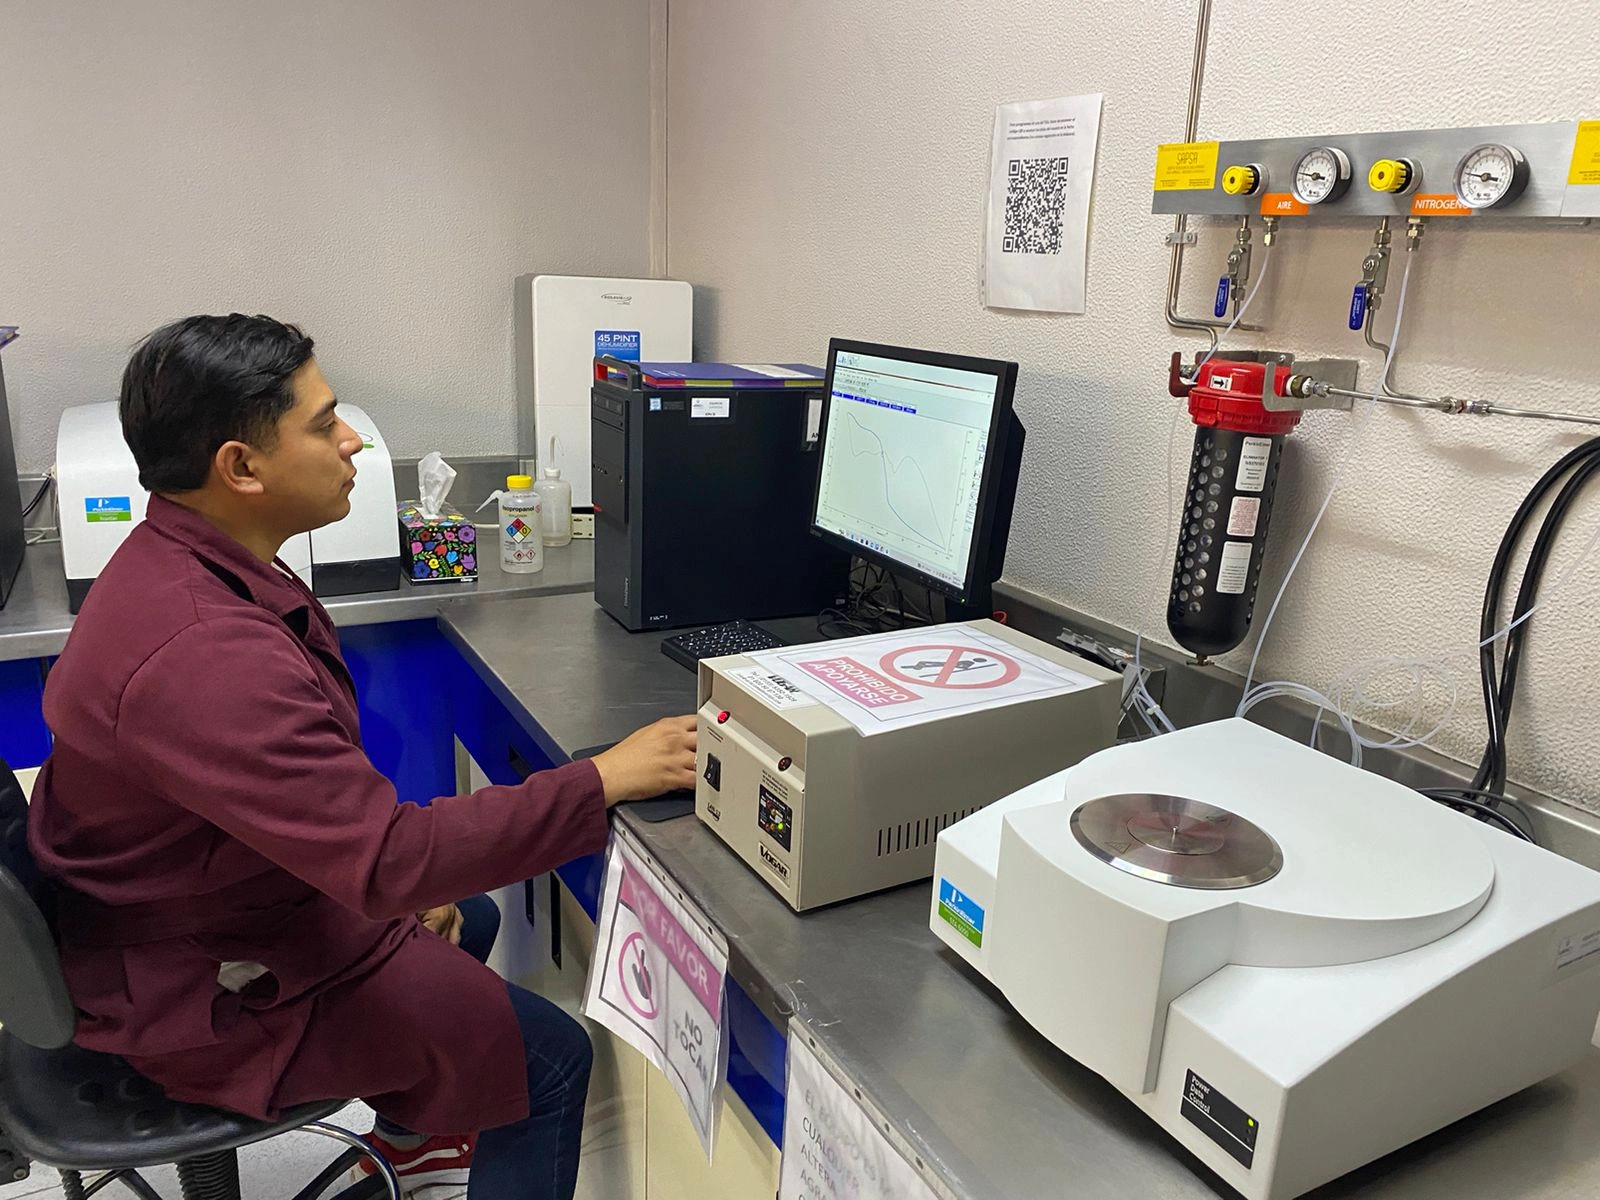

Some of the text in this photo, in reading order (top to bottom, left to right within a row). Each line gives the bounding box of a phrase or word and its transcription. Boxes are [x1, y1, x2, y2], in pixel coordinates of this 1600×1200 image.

[1276, 200, 1293, 210] AIRE
[597, 334, 638, 343] 45 PINT
[502, 504, 535, 513] Isopropanol
[521, 526, 528, 534] 0
[808, 663, 888, 704] APOYARSE
[828, 659, 909, 701] PROHIBIDO
[760, 845, 787, 877] VOGAR
[660, 915, 709, 995] FAVOR
[684, 1011, 703, 1046] NO
[1190, 1084, 1204, 1100] Data
[1192, 1075, 1210, 1094] Power
[1189, 1092, 1211, 1114] Control
